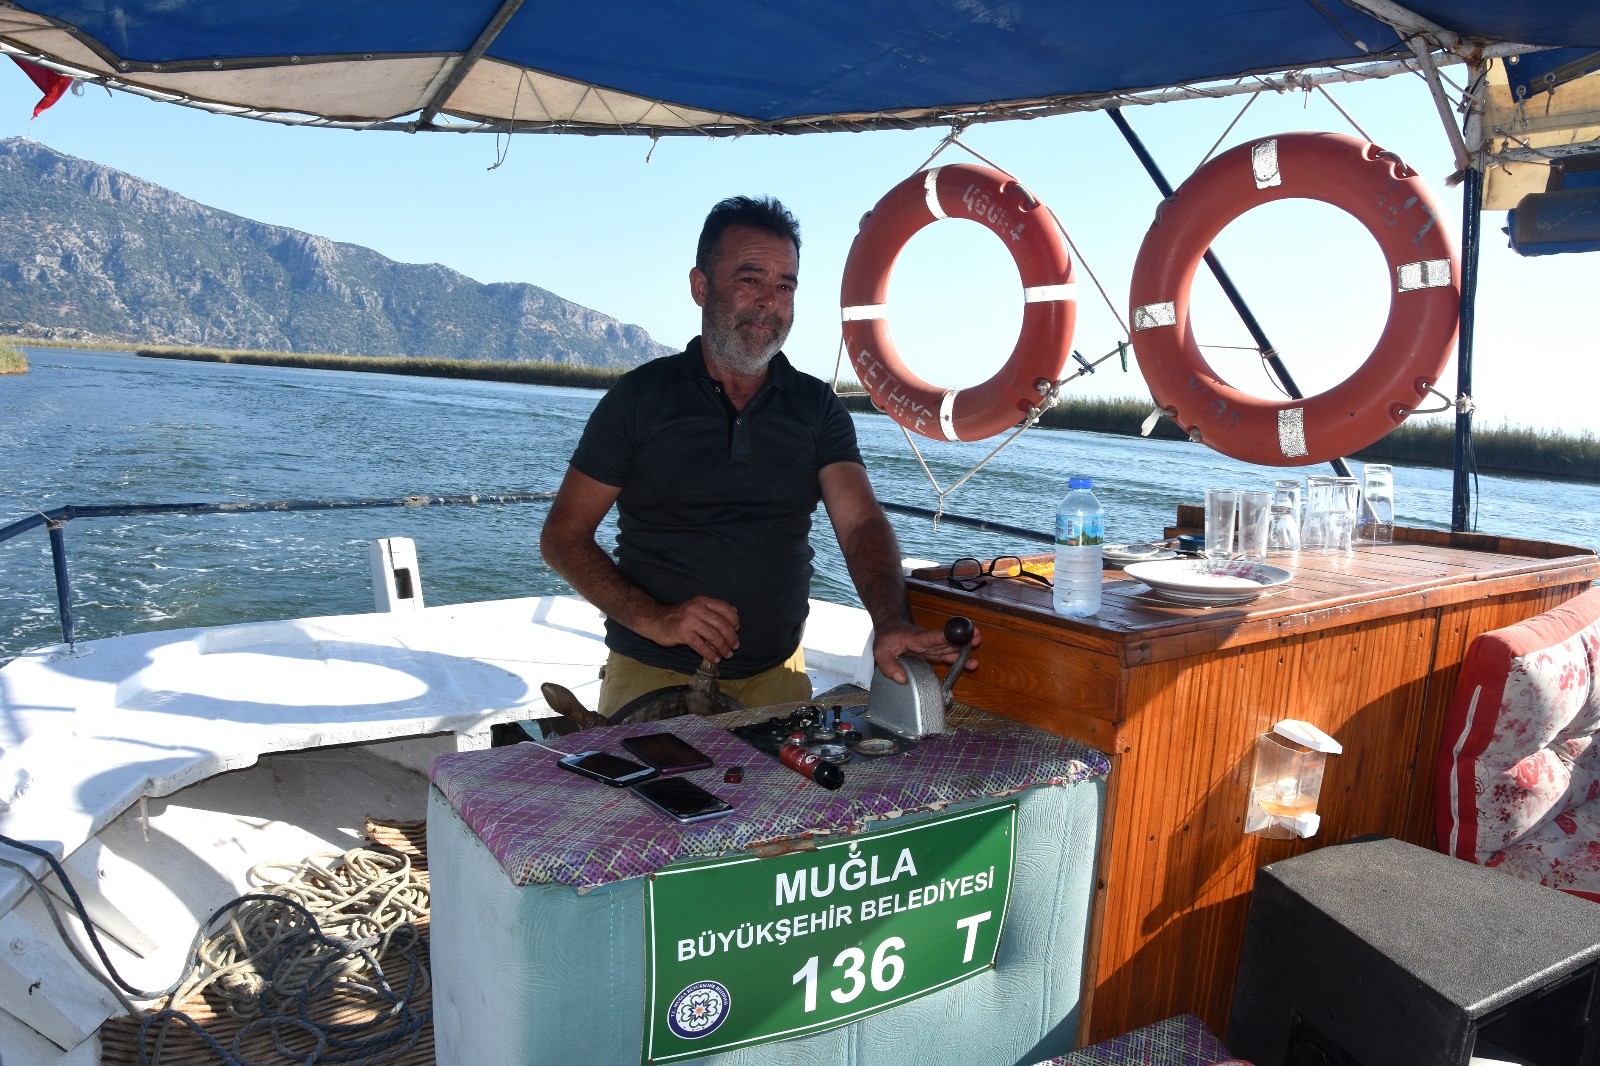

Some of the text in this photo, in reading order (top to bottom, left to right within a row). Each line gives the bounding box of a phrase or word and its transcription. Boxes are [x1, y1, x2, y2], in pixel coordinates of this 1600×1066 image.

[677, 866, 995, 962] BÜYÜKŞEHİR BELEDİYESİ
[775, 848, 918, 906] MUĞLA
[792, 911, 992, 1013] 136 T
